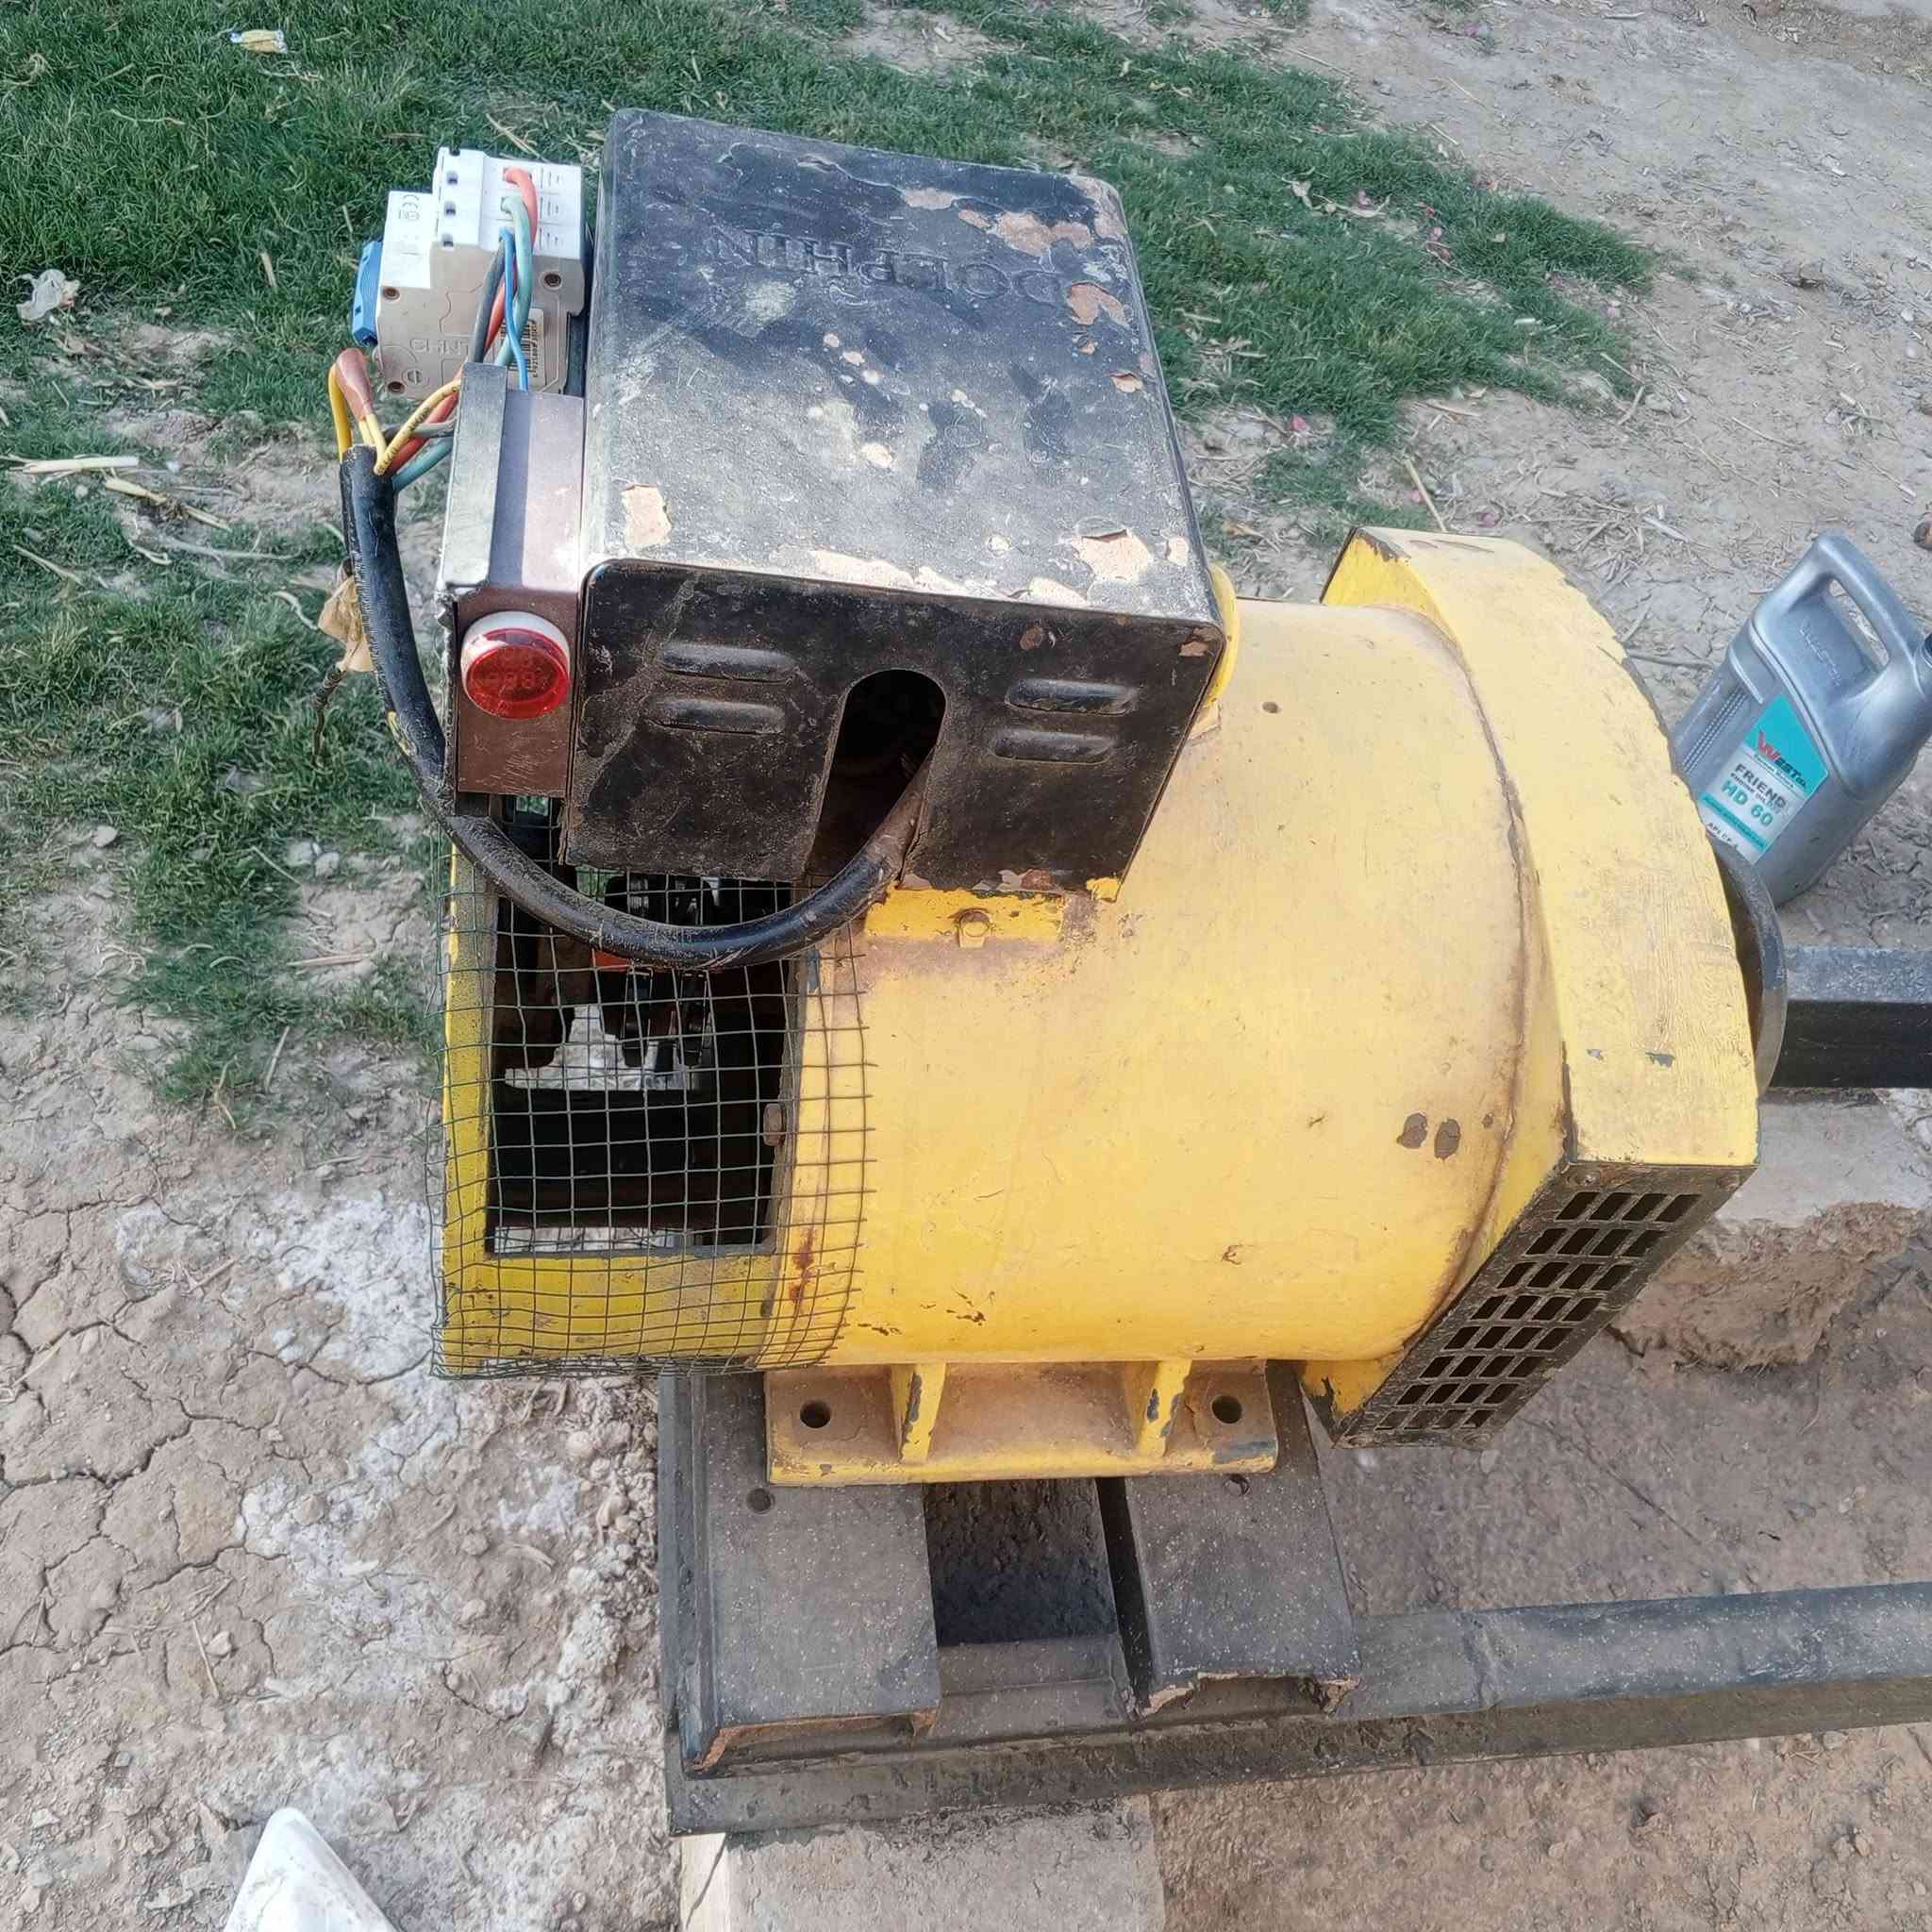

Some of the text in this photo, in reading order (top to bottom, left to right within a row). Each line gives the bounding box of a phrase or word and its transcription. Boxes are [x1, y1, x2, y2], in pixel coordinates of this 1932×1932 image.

[1721, 779, 1748, 805] HD
[1751, 803, 1774, 826] 60
[1735, 763, 1786, 808] FRIEND
